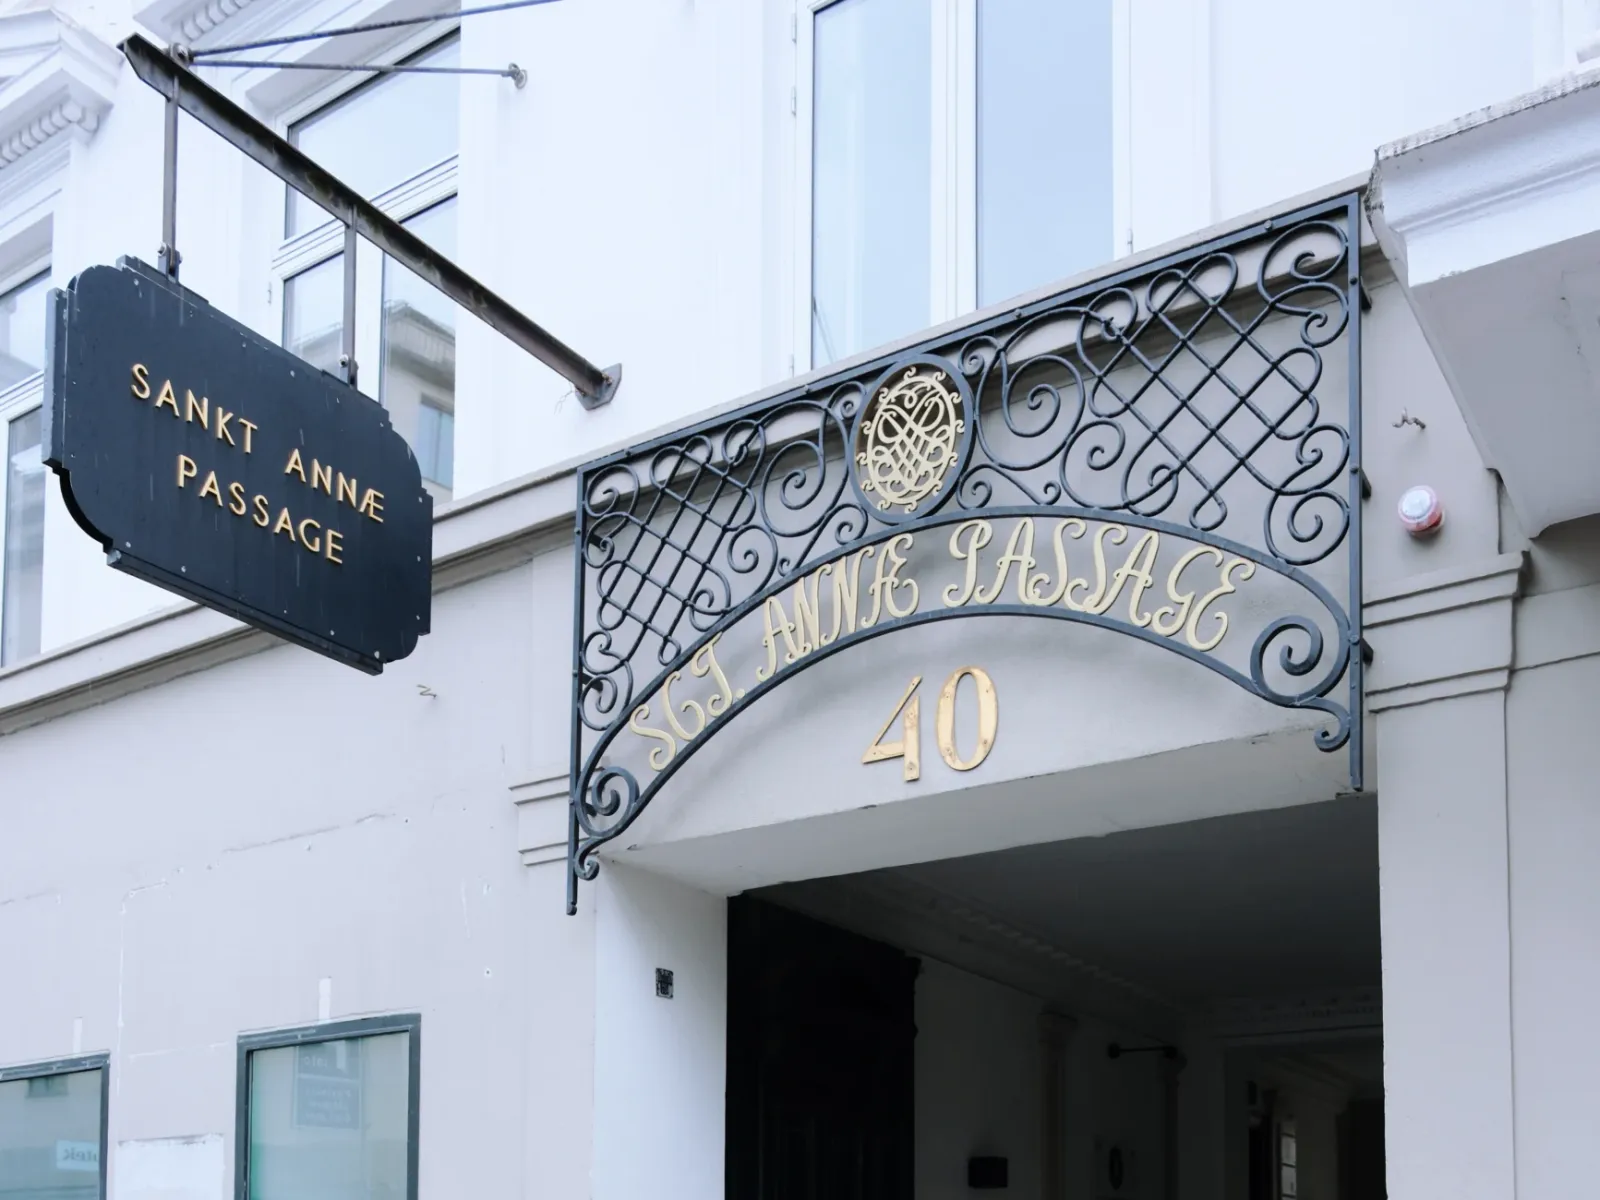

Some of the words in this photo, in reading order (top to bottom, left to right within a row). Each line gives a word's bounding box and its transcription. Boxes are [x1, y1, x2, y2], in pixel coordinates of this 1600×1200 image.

[130, 363, 258, 454] SANKT
[284, 448, 385, 524] ANNÆ
[176, 454, 344, 565] PASSAGE
[755, 532, 921, 683] ANNÆ
[942, 516, 1256, 652] PASSAGE
[861, 665, 998, 783] 40
